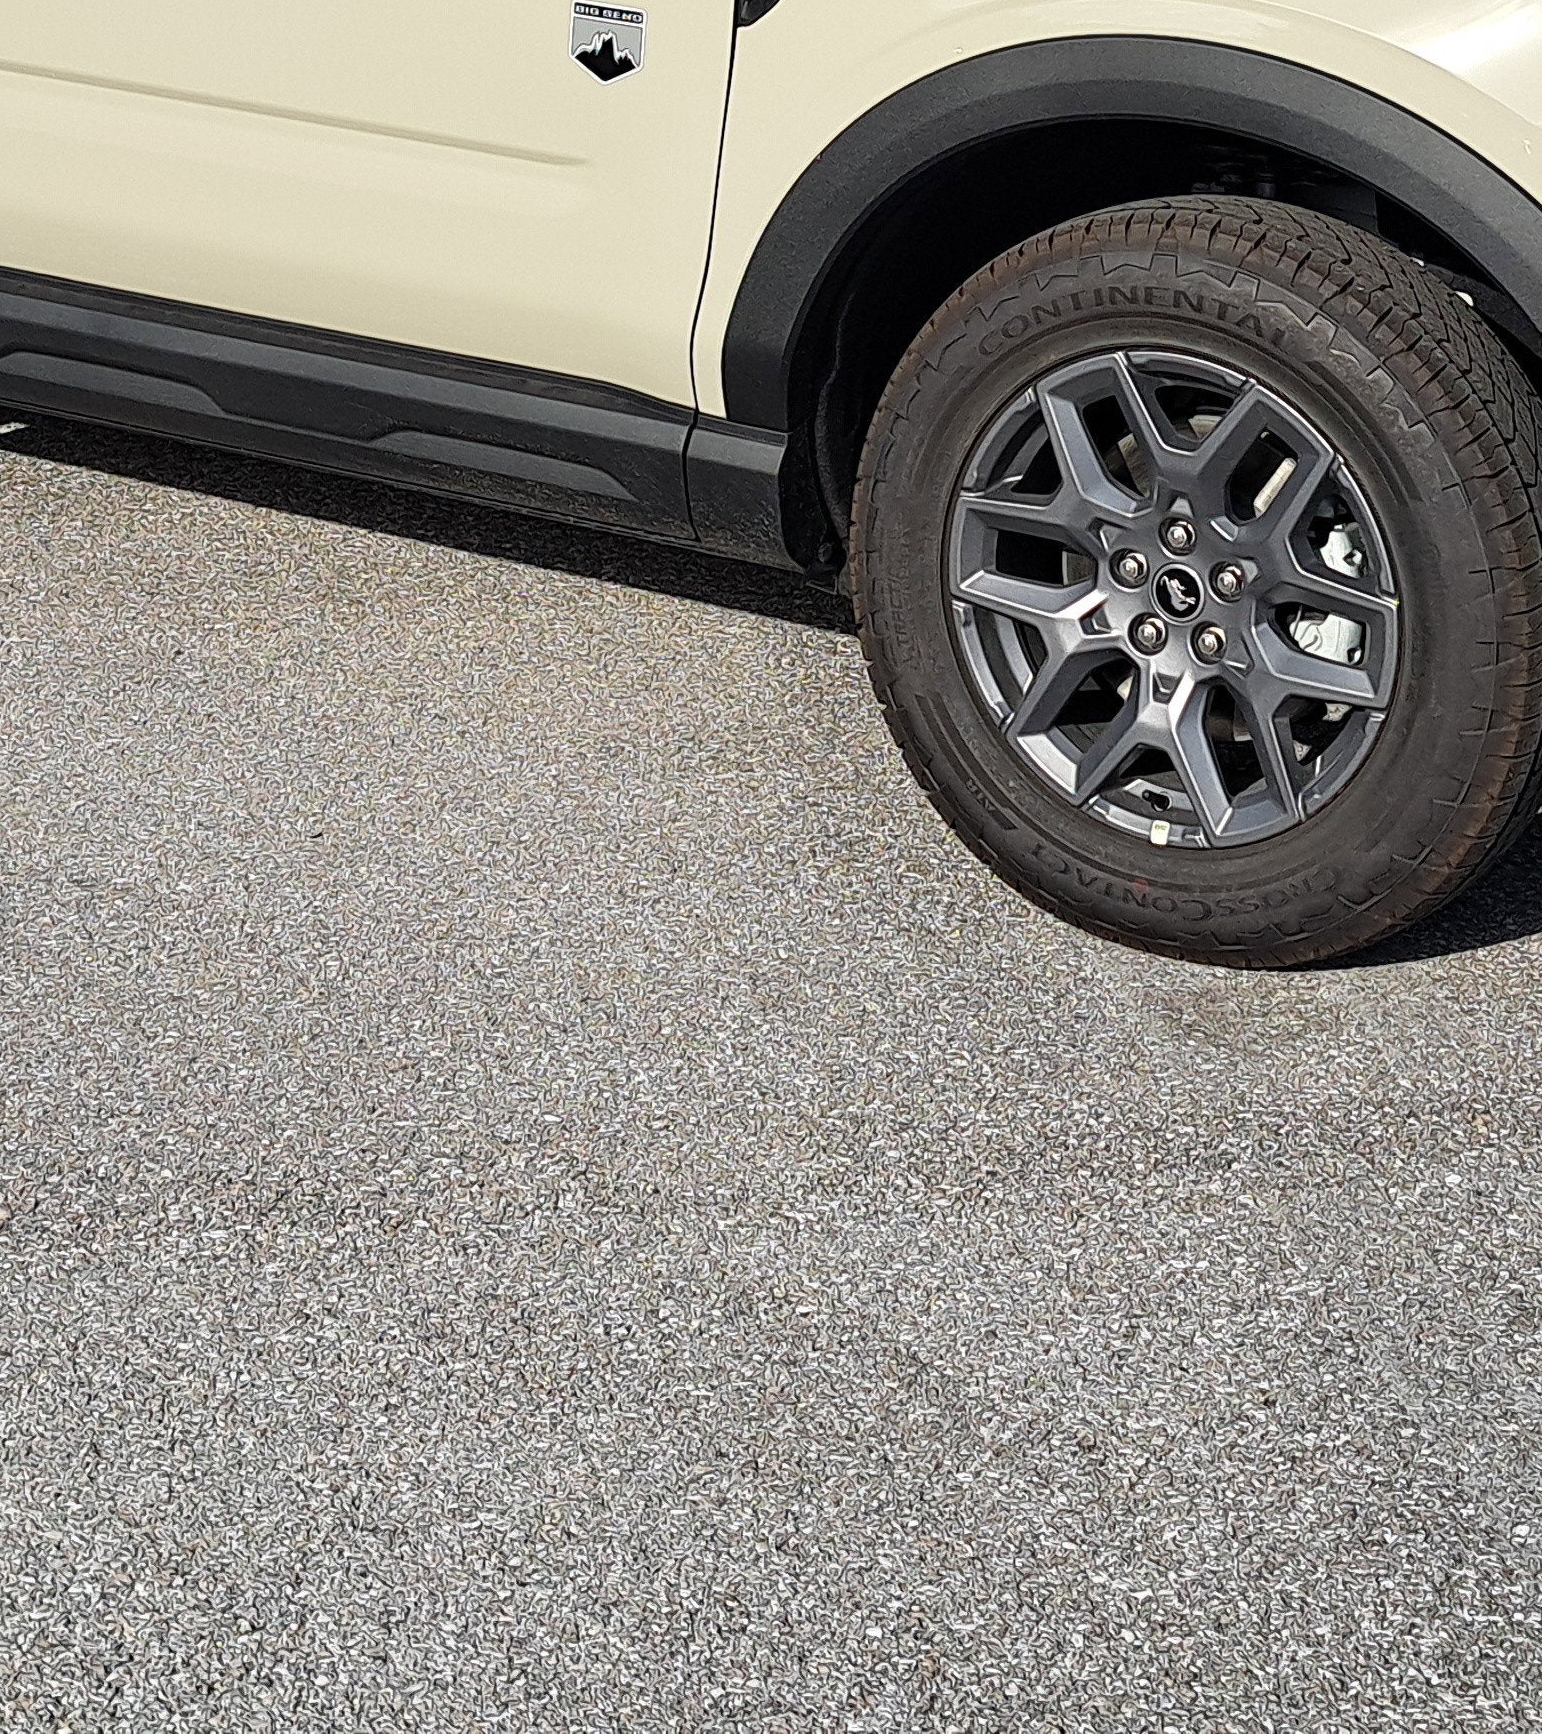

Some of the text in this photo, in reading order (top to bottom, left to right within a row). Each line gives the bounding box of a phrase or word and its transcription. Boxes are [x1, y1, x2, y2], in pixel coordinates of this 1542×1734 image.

[576, 5, 642, 22] BIG BEND
[977, 284, 1286, 358] CONTINENTAL
